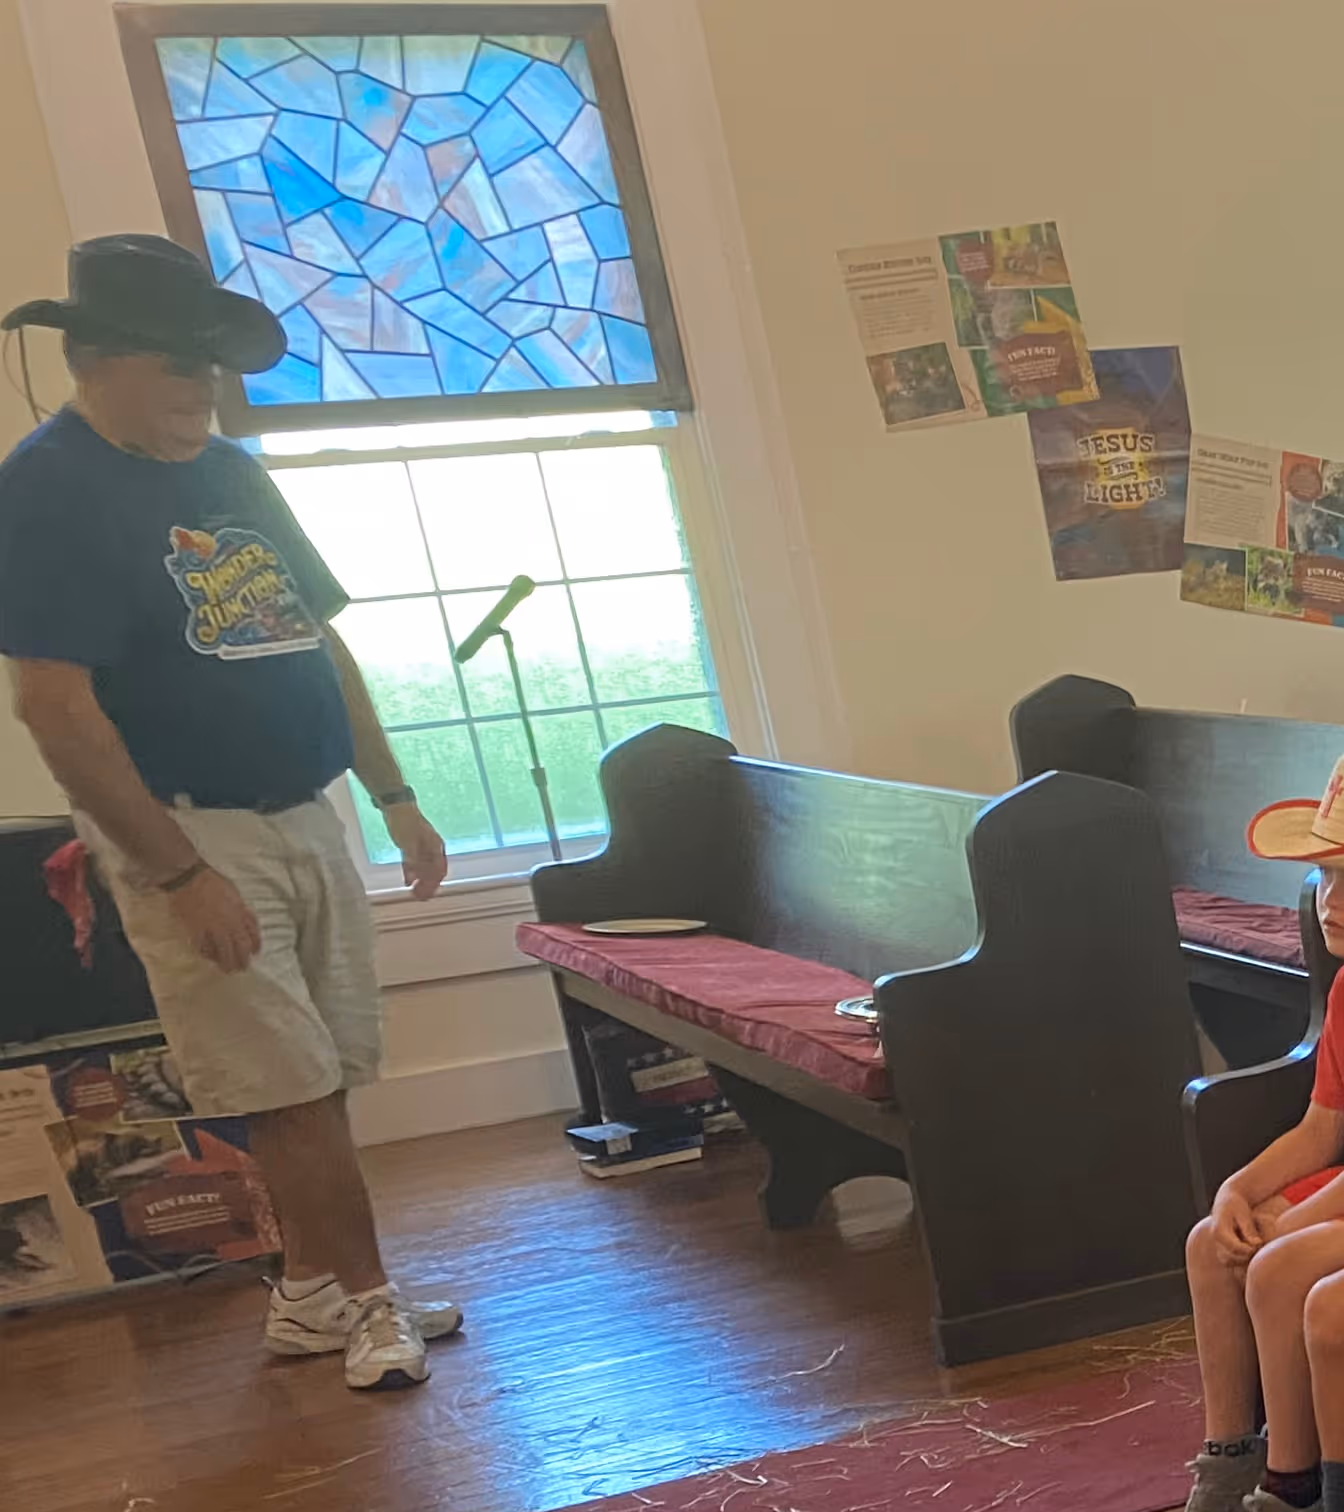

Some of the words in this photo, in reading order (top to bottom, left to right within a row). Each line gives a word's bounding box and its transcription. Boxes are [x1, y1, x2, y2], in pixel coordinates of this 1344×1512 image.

[1078, 433, 1154, 459] JESUS
[1115, 461, 1136, 473] THE
[1084, 477, 1166, 503] LIGHT!
